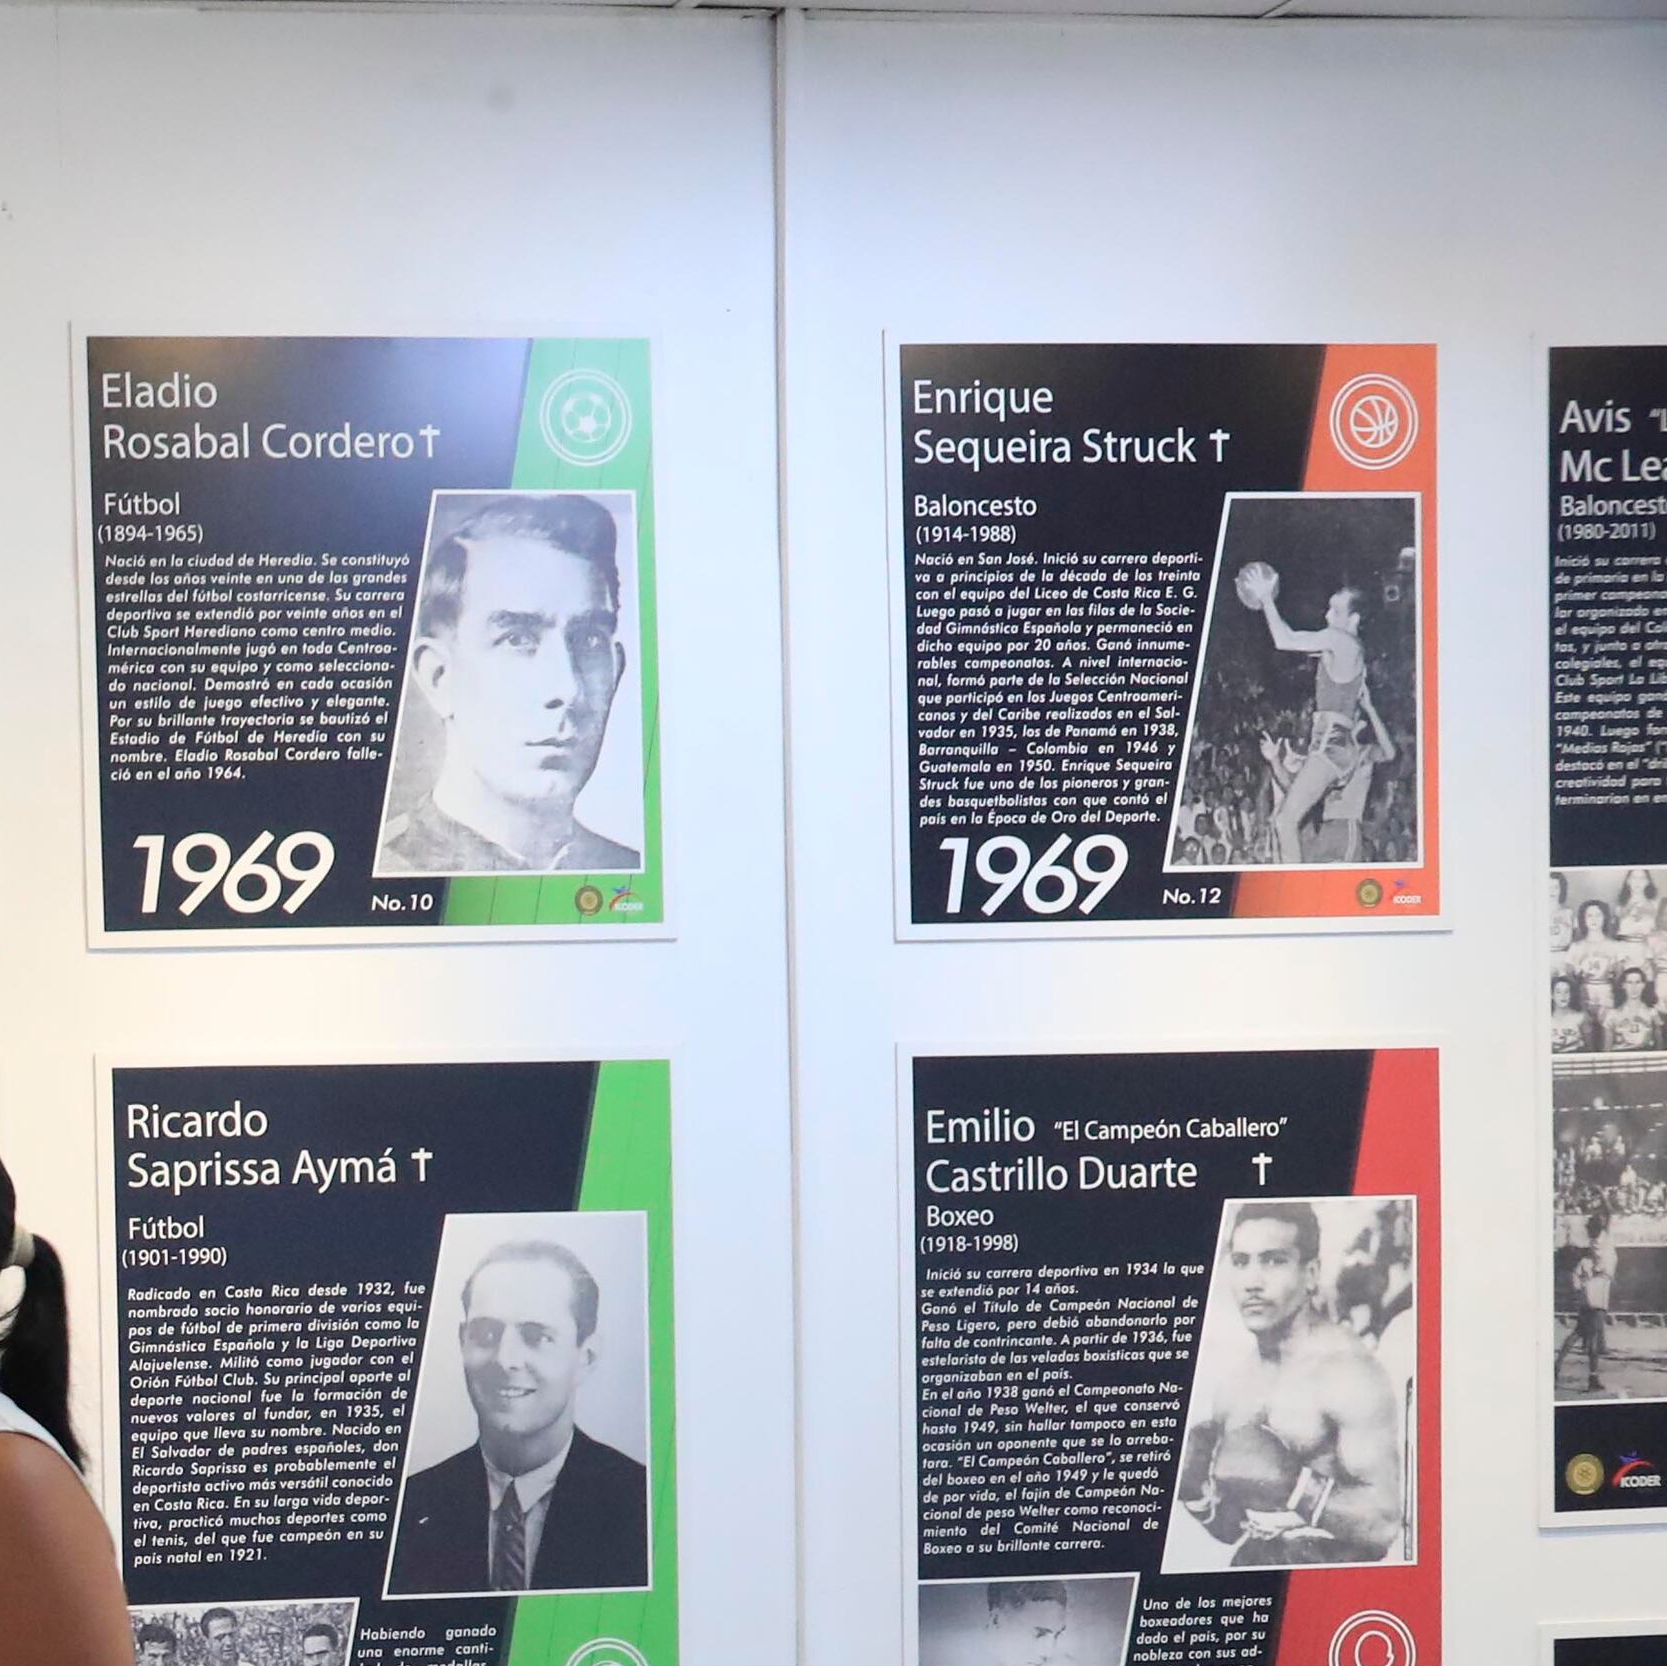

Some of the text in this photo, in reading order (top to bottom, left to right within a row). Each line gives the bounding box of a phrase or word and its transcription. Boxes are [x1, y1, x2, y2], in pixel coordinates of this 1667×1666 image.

[103, 372, 217, 408] Eladio
[914, 380, 1053, 422] Enrique
[1559, 400, 1631, 433] Avis
[105, 422, 414, 459] Rosabal Cordero
[915, 428, 1196, 471] Sequeira Struck
[1561, 450, 1612, 482] Mc
[105, 492, 180, 515] Fútbol
[915, 494, 1037, 517] Baloncesto
[98, 524, 203, 544] (1894-1965)
[917, 525, 1016, 545] (1914-1988)
[1558, 522, 1656, 542] (1980-2011)
[111, 766, 245, 781] ció en el año 1964.
[133, 831, 334, 916] 1969
[940, 834, 1128, 916] 1969
[372, 894, 433, 911] No.10
[1163, 888, 1221, 904] No.12
[128, 1101, 267, 1138] Ricardo
[928, 1107, 1035, 1143] Emilio
[1085, 1119, 1181, 1144] Campeón
[129, 1148, 396, 1196] Saprissa Aymá
[927, 1156, 1197, 1193] Castrillo Duarte
[129, 1216, 204, 1239] Fútbol
[927, 1206, 994, 1227] Boxeo
[121, 1246, 228, 1269] (1901-1990)
[921, 1234, 1018, 1254] (1918-1998)
